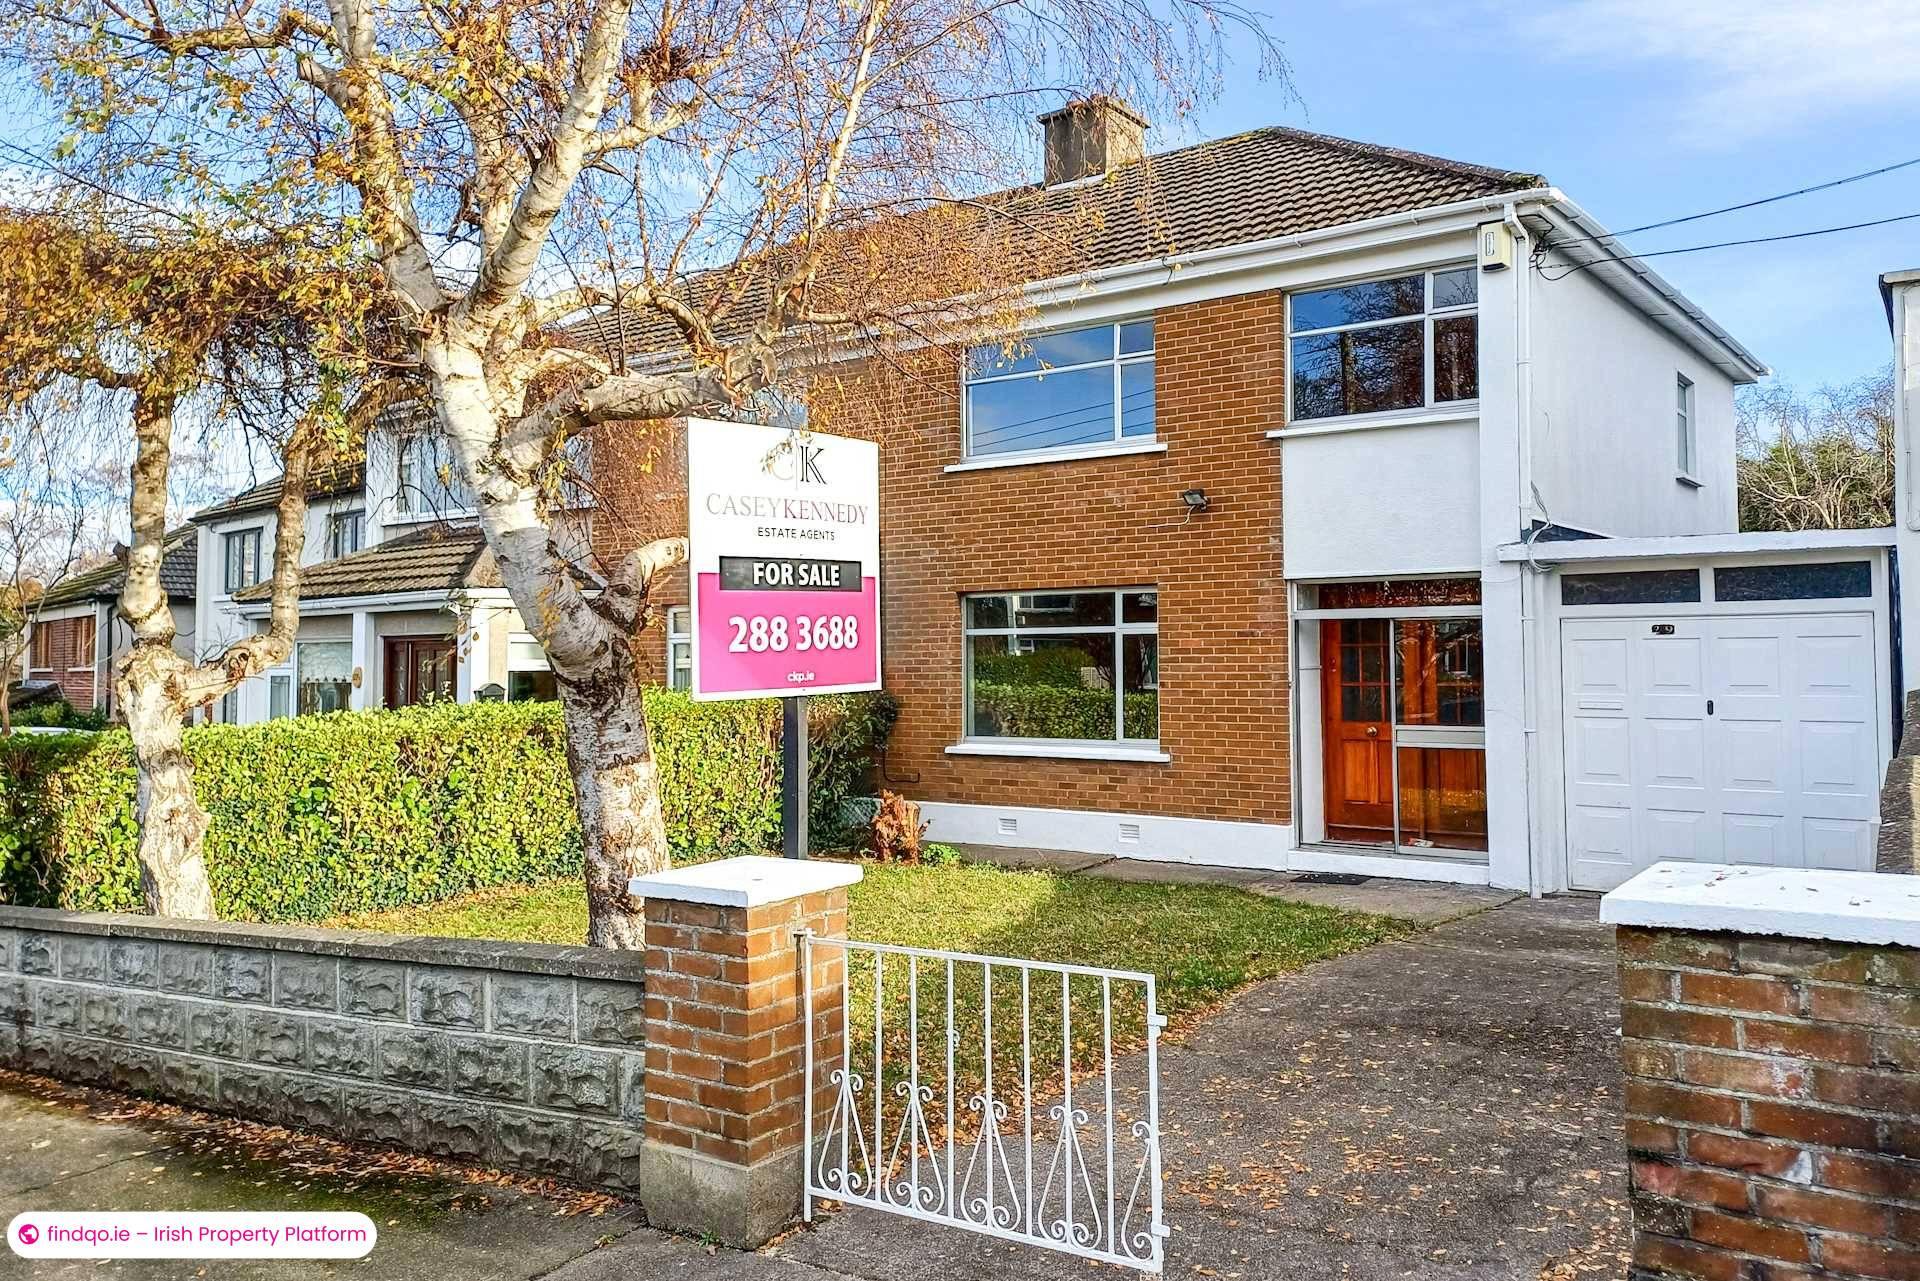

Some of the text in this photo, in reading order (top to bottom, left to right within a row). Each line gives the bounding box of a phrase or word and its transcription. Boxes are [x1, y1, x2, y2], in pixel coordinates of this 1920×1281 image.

[757, 527, 835, 541] ESTATE AGENTS
[753, 562, 840, 587] FOR SALE
[728, 615, 859, 653] 288 3688
